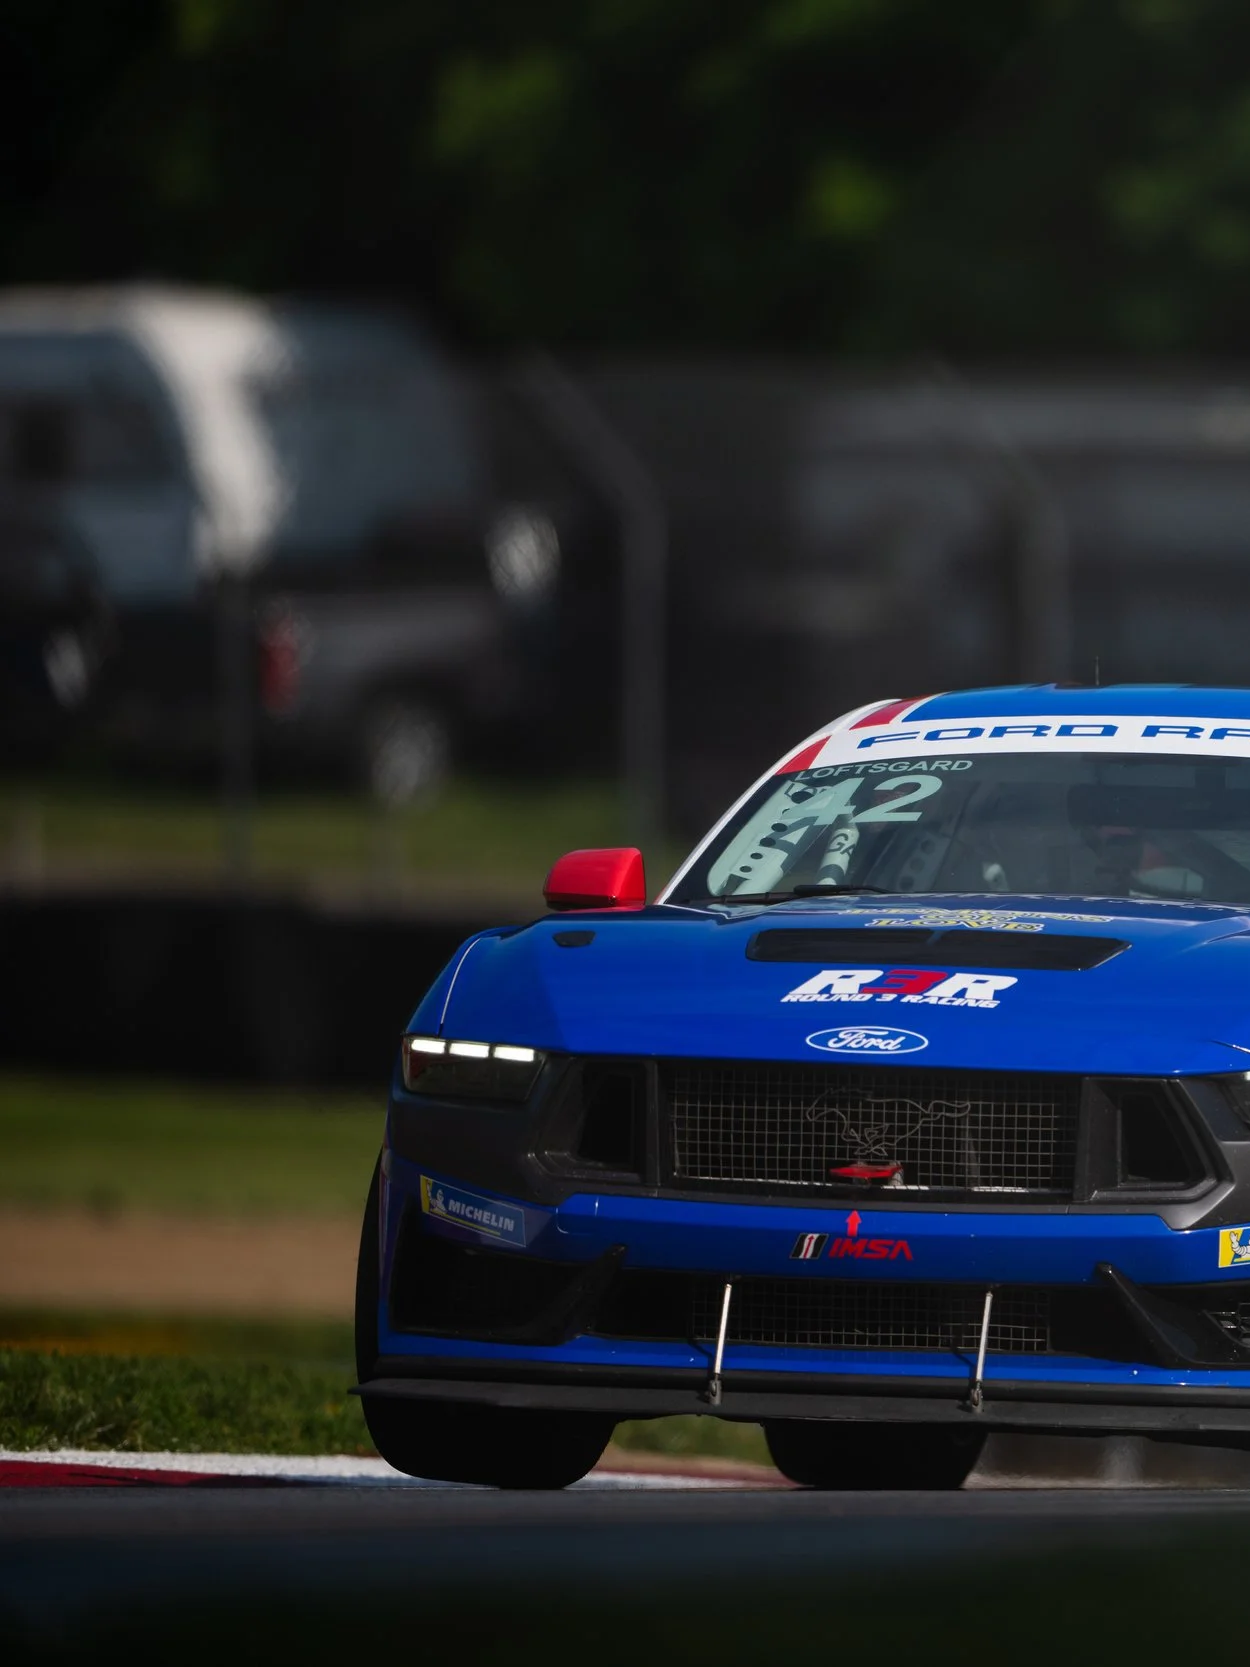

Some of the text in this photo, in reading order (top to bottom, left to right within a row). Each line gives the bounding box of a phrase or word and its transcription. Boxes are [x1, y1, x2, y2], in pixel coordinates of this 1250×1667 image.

[857, 724, 1119, 749] FORD
[795, 760, 973, 781] LOFTSGARD
[780, 774, 943, 826] 42
[864, 918, 1045, 932] LOVE
[789, 969, 1019, 1000] R3R
[780, 993, 1001, 1009] ROUND 3 RACING
[827, 1028, 906, 1051] Ford
[448, 1199, 515, 1232] MICHELIN
[828, 1237, 913, 1261] IMSA
